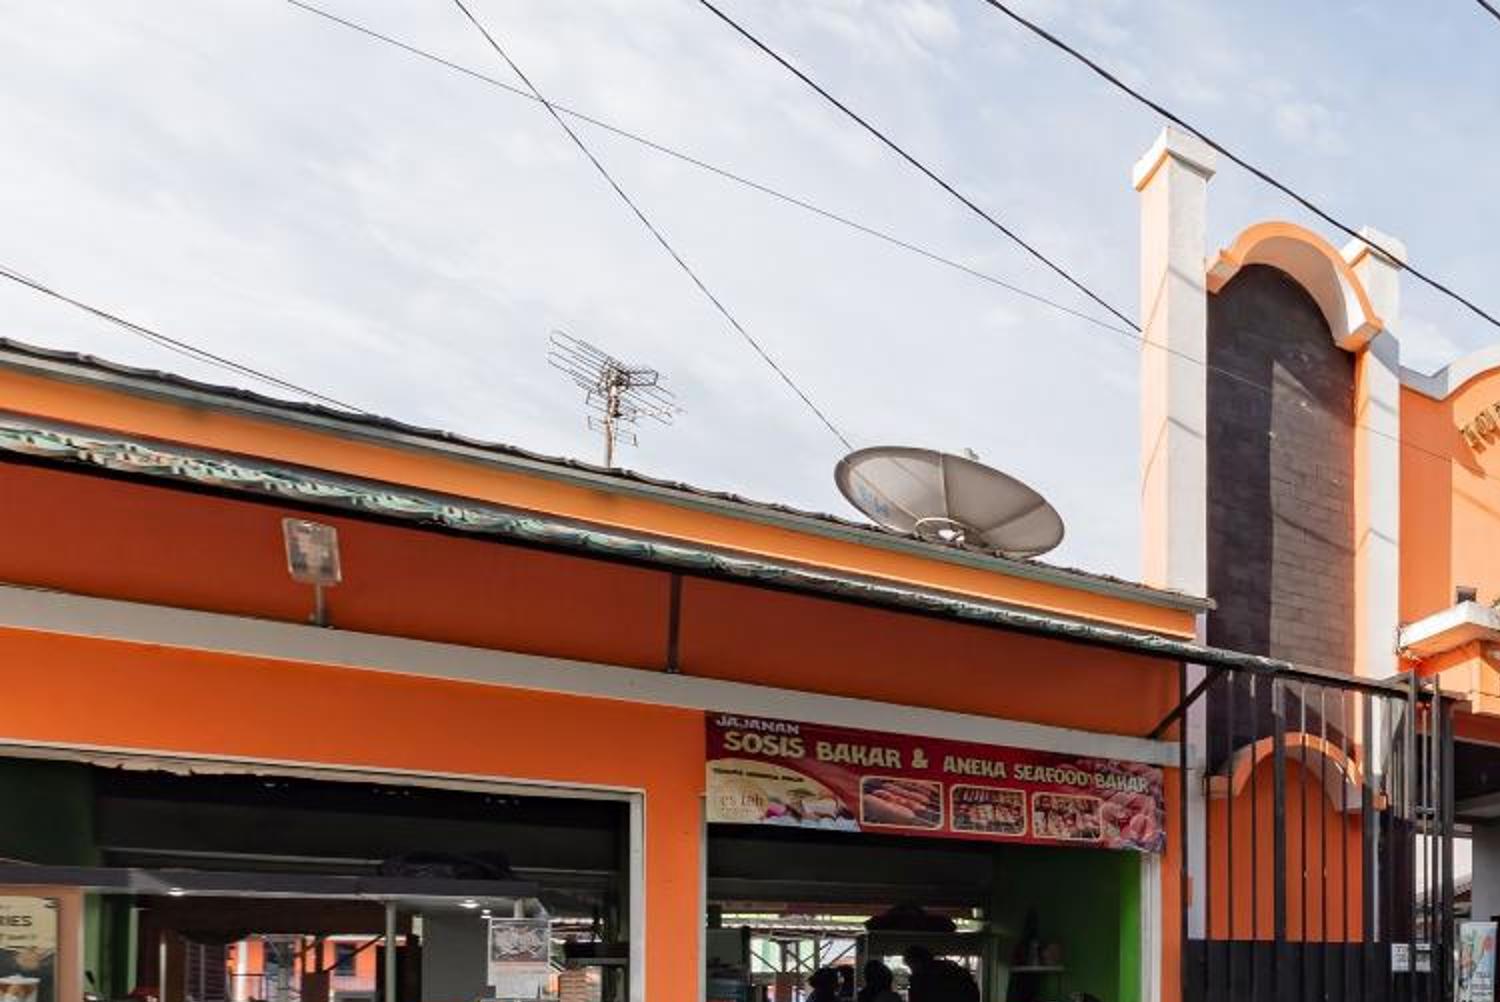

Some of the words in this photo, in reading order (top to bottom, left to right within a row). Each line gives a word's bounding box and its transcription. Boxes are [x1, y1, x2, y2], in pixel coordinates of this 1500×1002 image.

[716, 715, 800, 735] JAJANAN
[723, 731, 805, 759] SOSIS
[816, 741, 902, 769] BAKAR
[911, 748, 929, 769] &
[943, 755, 1007, 779] ANEKA
[1014, 765, 1088, 787] SEAFOOD
[1095, 773, 1150, 794] BAKAR
